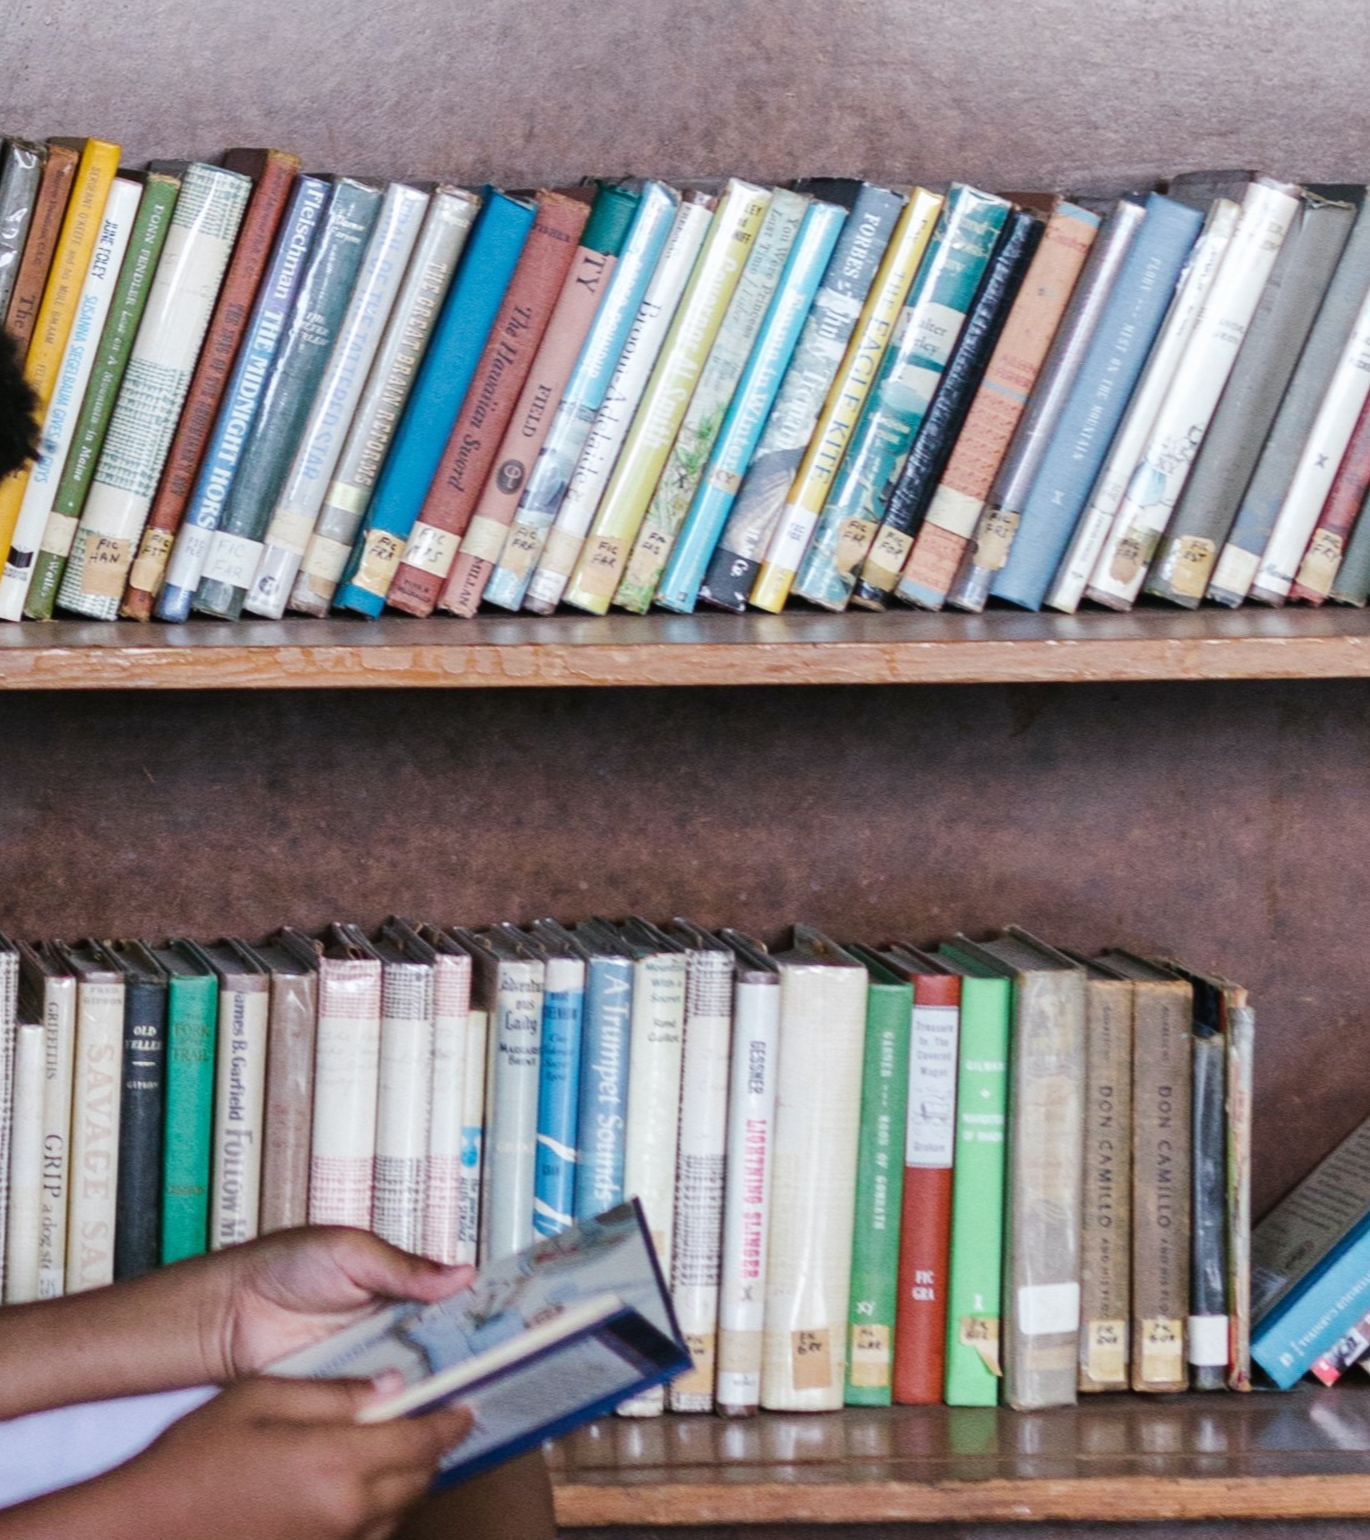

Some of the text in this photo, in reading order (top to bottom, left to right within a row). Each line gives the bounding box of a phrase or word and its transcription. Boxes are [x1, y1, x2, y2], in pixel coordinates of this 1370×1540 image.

[273, 186, 327, 300] Fleischman
[447, 305, 534, 492] The Hawaiian Sword
[592, 974, 624, 1200] A Trumpet Sounds
[1156, 1085, 1172, 1229] DON CAMILLO
[742, 1041, 766, 1279] GESSNER LIGHTNING SLINGER
[913, 1287, 935, 1300] GRA
[914, 1270, 934, 1283] FIC
